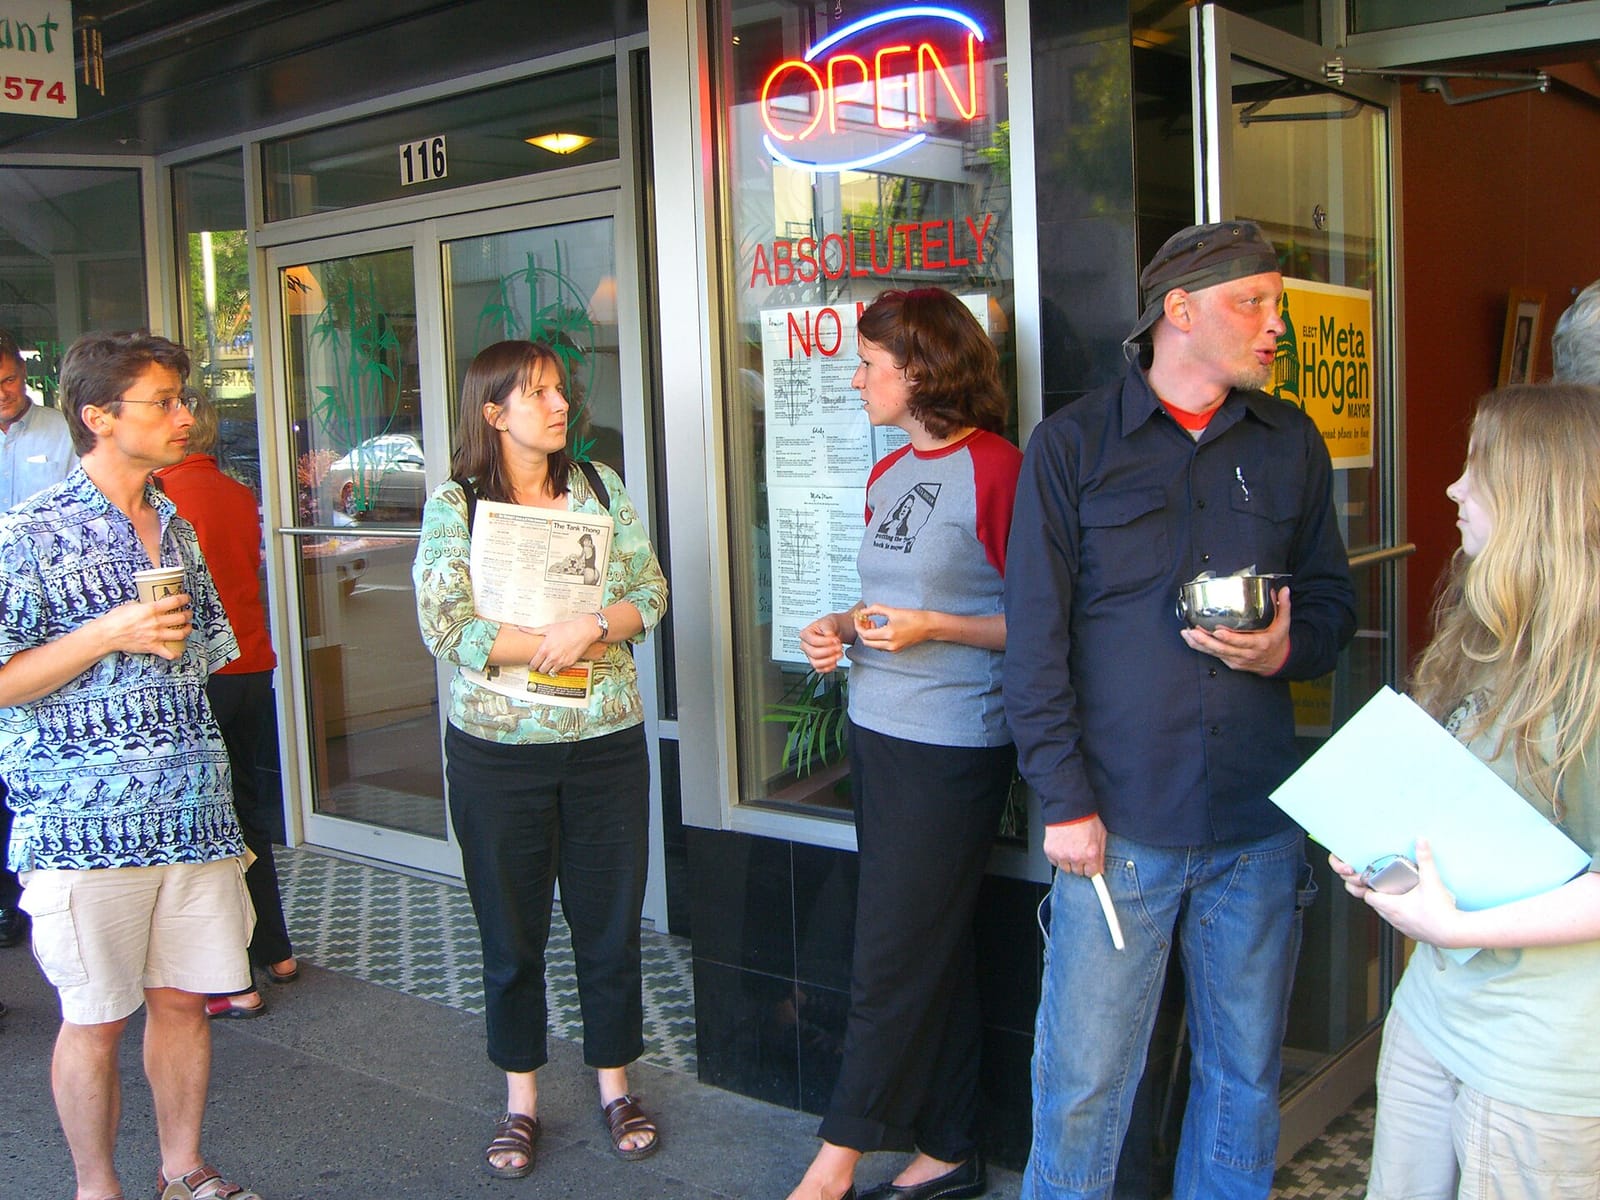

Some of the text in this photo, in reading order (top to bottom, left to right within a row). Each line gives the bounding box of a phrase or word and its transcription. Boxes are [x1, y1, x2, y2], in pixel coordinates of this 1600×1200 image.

[0, 76, 67, 104] 574
[761, 31, 978, 141] OPEN
[403, 138, 445, 183] 116
[750, 213, 993, 289] ABSOLUTELY
[787, 307, 842, 359] NO
[1303, 315, 1365, 358] ELECT Meta
[1303, 342, 1369, 415] Hogan
[1347, 403, 1370, 418] MAYOR
[553, 522, 564, 530] The
[583, 526, 601, 535] Thong
